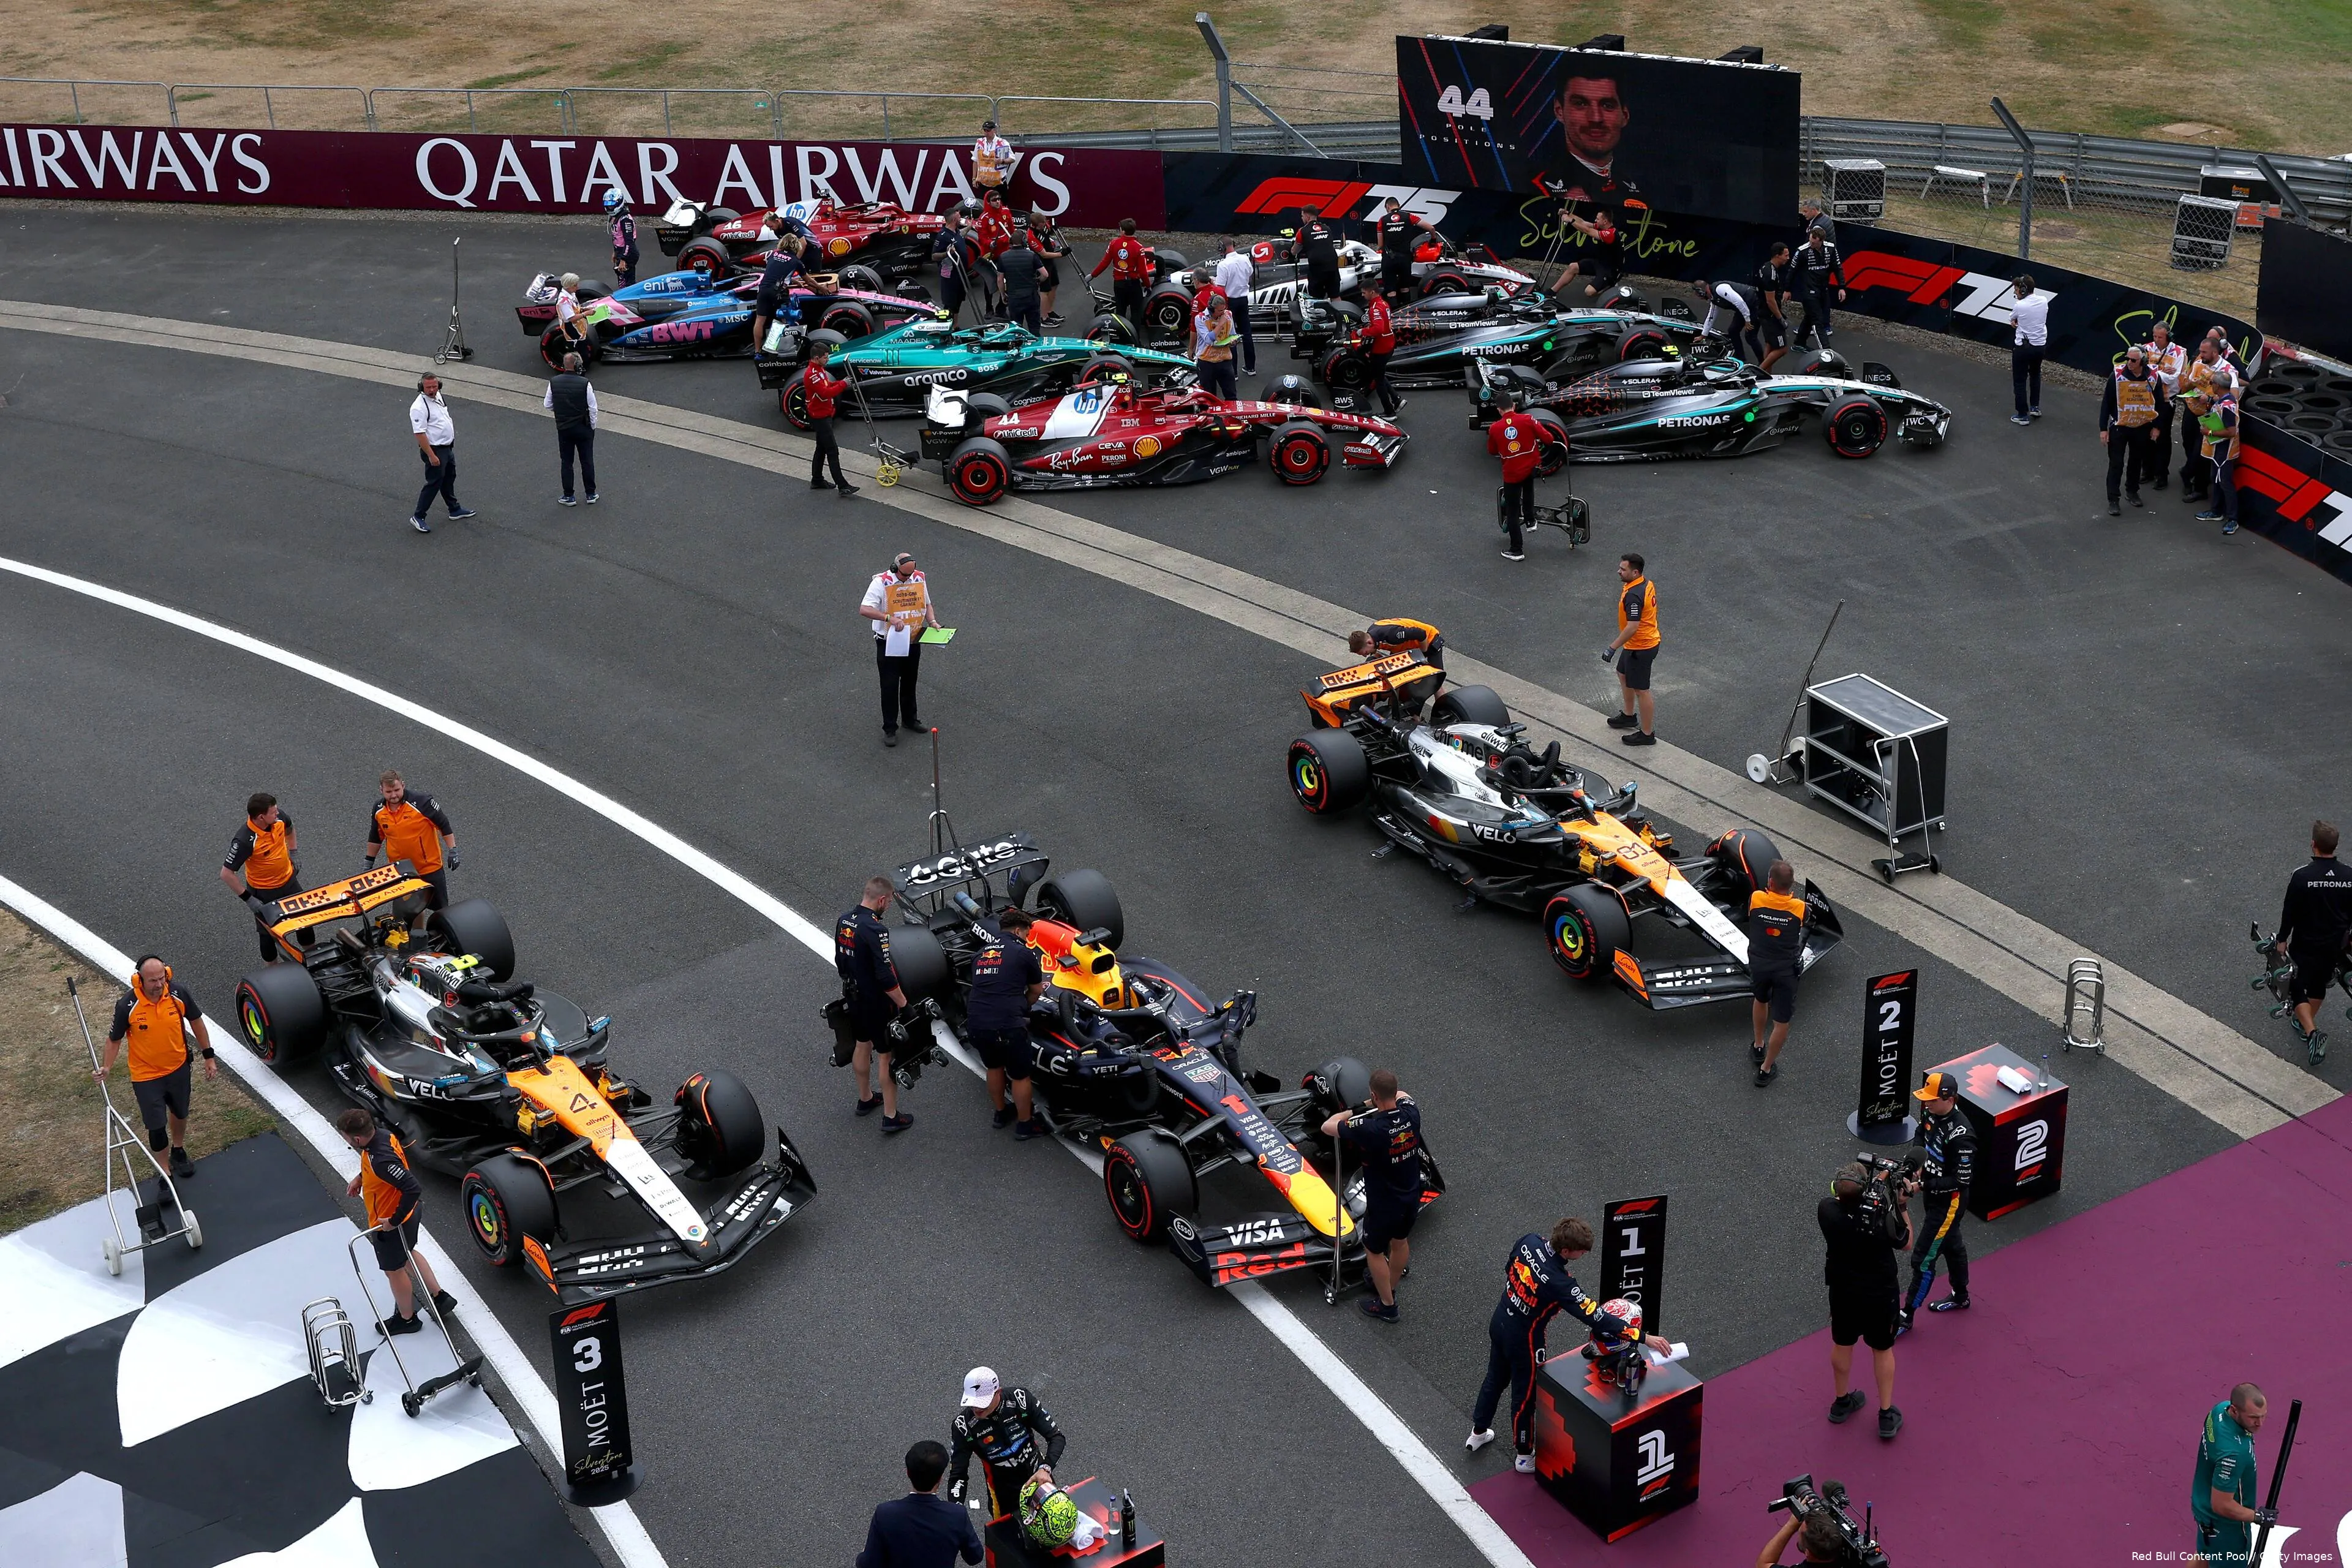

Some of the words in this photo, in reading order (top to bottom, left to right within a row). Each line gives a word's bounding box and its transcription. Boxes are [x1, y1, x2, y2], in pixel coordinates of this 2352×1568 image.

[1438, 85, 1494, 121] 44
[1446, 123, 1488, 133] POLE
[1420, 134, 1516, 151] POSITIONS
[0, 127, 270, 194] IRWAYS
[416, 137, 682, 208] QATAR
[714, 144, 1066, 217] AIRWAS
[788, 204, 805, 221] hp
[723, 220, 742, 230] 16
[644, 279, 665, 291] eni
[1664, 307, 1689, 316] INEOS
[725, 313, 748, 324] MSC
[1457, 319, 1498, 328] TeamViewer
[652, 321, 714, 342] BWT
[831, 344, 840, 352] 14
[1462, 343, 1529, 356] PETRONAS
[1691, 345, 1709, 354] IWC
[978, 364, 999, 372] BOSS
[904, 369, 967, 387] aramco
[1865, 374, 1891, 383] INEOS
[1546, 382, 1558, 391] 12
[1651, 388, 1695, 397] TeamViewer
[1014, 395, 1047, 406] cognizant
[1334, 396, 1353, 404] aws
[998, 412, 1020, 426] 44
[1121, 418, 1140, 427] IBM
[1657, 414, 1730, 428] PETRONAS
[1905, 417, 1924, 426] IWC
[1003, 428, 1038, 438] UniCredit
[1226, 449, 1250, 458] ambipar
[1210, 465, 1229, 475] VGW
[2317, 491, 2352, 554] 7
[1480, 731, 1508, 750] allwyn
[1412, 742, 1426, 758] DELL
[1410, 834, 1425, 845] KAUST
[1472, 823, 1517, 844] VELO
[1641, 859, 1660, 867] allwyn
[296, 915, 314, 925] The
[316, 908, 342, 921] New
[383, 884, 405, 899] App
[1757, 913, 1789, 922] McLaren
[1617, 960, 1636, 973] workday
[434, 964, 461, 987] allwyn
[1133, 981, 1150, 993] VISA
[1879, 1000, 1901, 1032] 2
[1172, 1054, 1210, 1071] ORACLE
[1878, 1038, 1898, 1096] MOËT
[1093, 1065, 1118, 1074] YETI
[1188, 1065, 1213, 1077] TAG
[1193, 1070, 1218, 1082] HEUER
[363, 1088, 378, 1100] KAUST
[569, 1092, 598, 1114] 4
[1220, 1094, 1250, 1115] 1
[586, 1114, 611, 1126] allwyn
[1239, 1114, 1259, 1124] VISA
[595, 1123, 619, 1136] Hilton
[1256, 1125, 1268, 1134] AT&T
[1389, 1121, 1412, 1134] ORACLE
[2015, 1119, 2049, 1171] 2
[1276, 1158, 1296, 1167] PIRELLI
[1221, 1218, 1285, 1246] VISA
[1620, 1227, 1646, 1257] 1
[1216, 1242, 1306, 1284] Red
[1520, 1244, 1550, 1284] ORACLE
[573, 1336, 602, 1373] 3
[580, 1381, 610, 1448] MOËT
[976, 1426, 993, 1438] Android
[575, 1449, 624, 1475] Silverstone
[1637, 1429, 1675, 1487] 1
[590, 1464, 610, 1476] 2025
